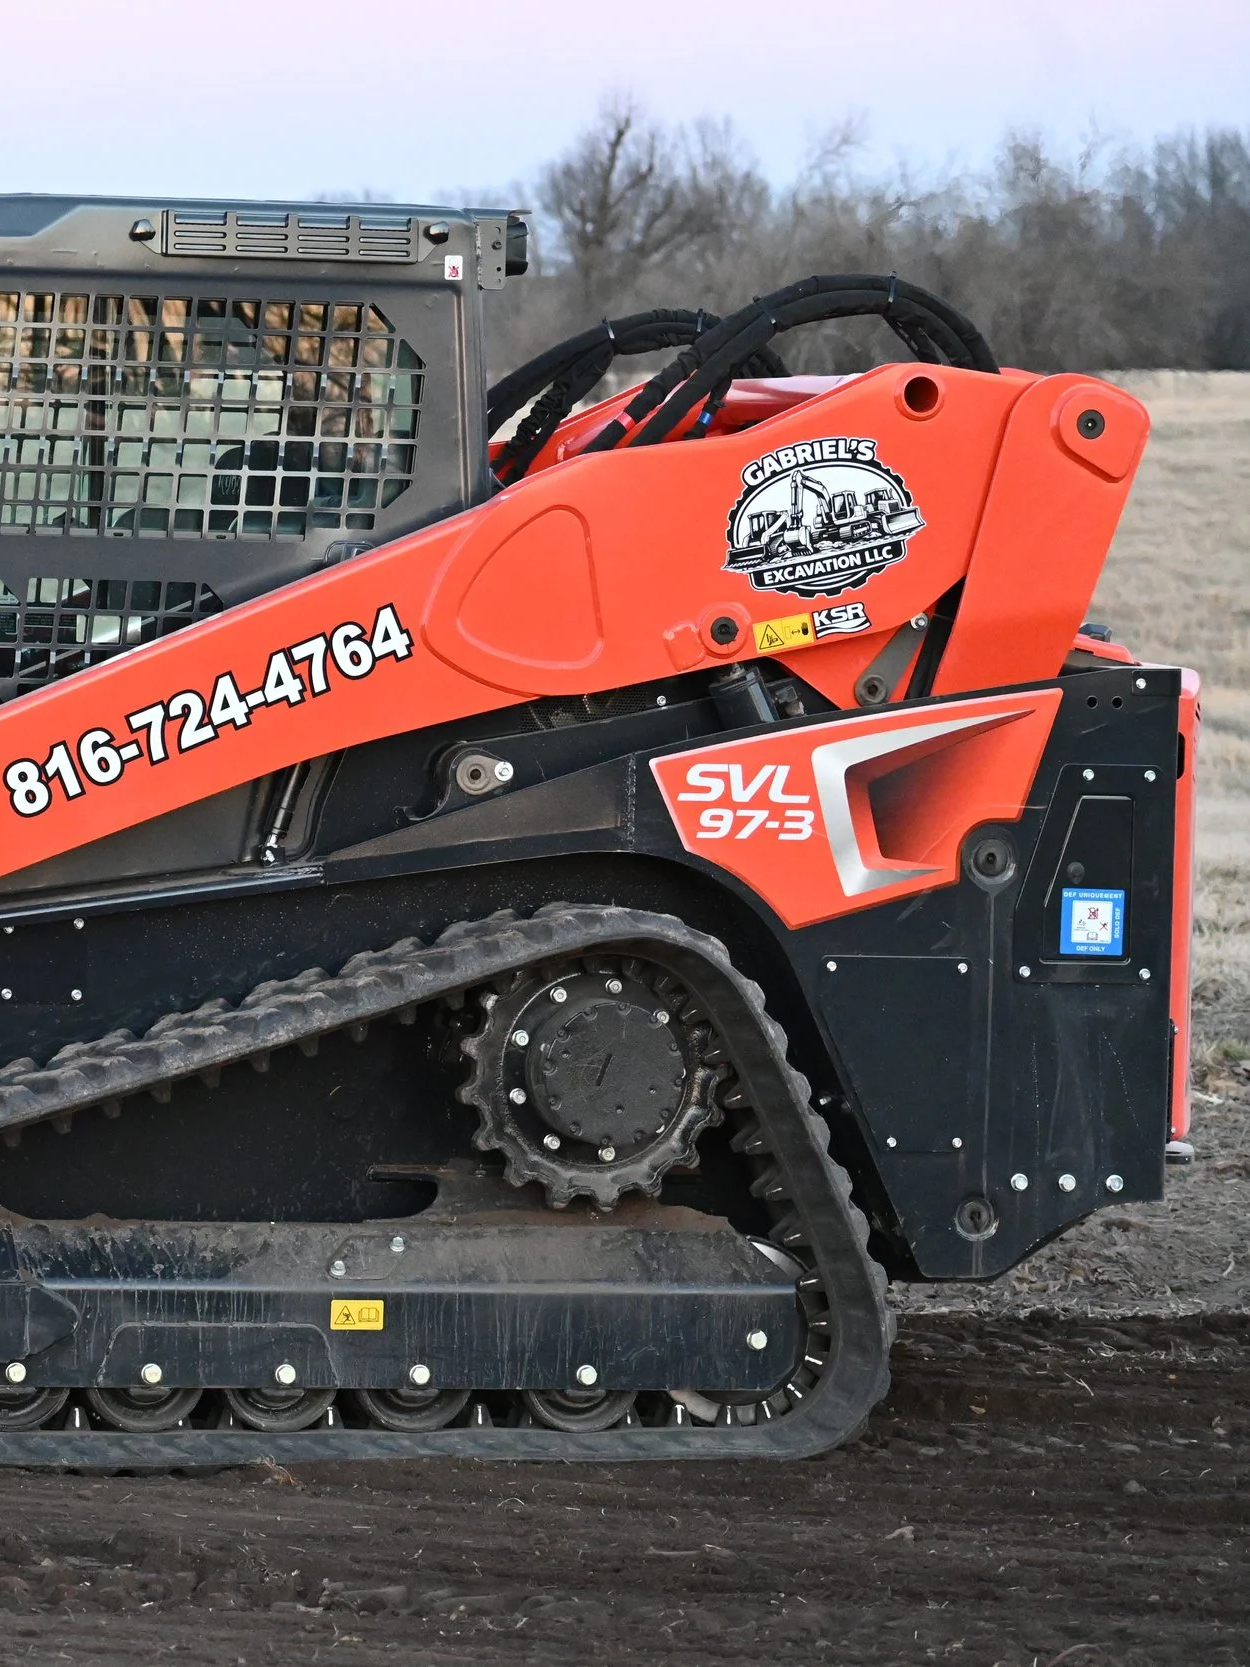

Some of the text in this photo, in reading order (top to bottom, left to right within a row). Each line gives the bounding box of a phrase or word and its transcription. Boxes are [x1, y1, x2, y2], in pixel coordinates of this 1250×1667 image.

[742, 439, 876, 487] GABRIEL'S
[763, 545, 894, 586] EXCAVATION LLC
[812, 603, 866, 628] KSR
[5, 605, 412, 816] 816-724-4764
[676, 763, 811, 804] SVL
[695, 807, 815, 841] 97-3
